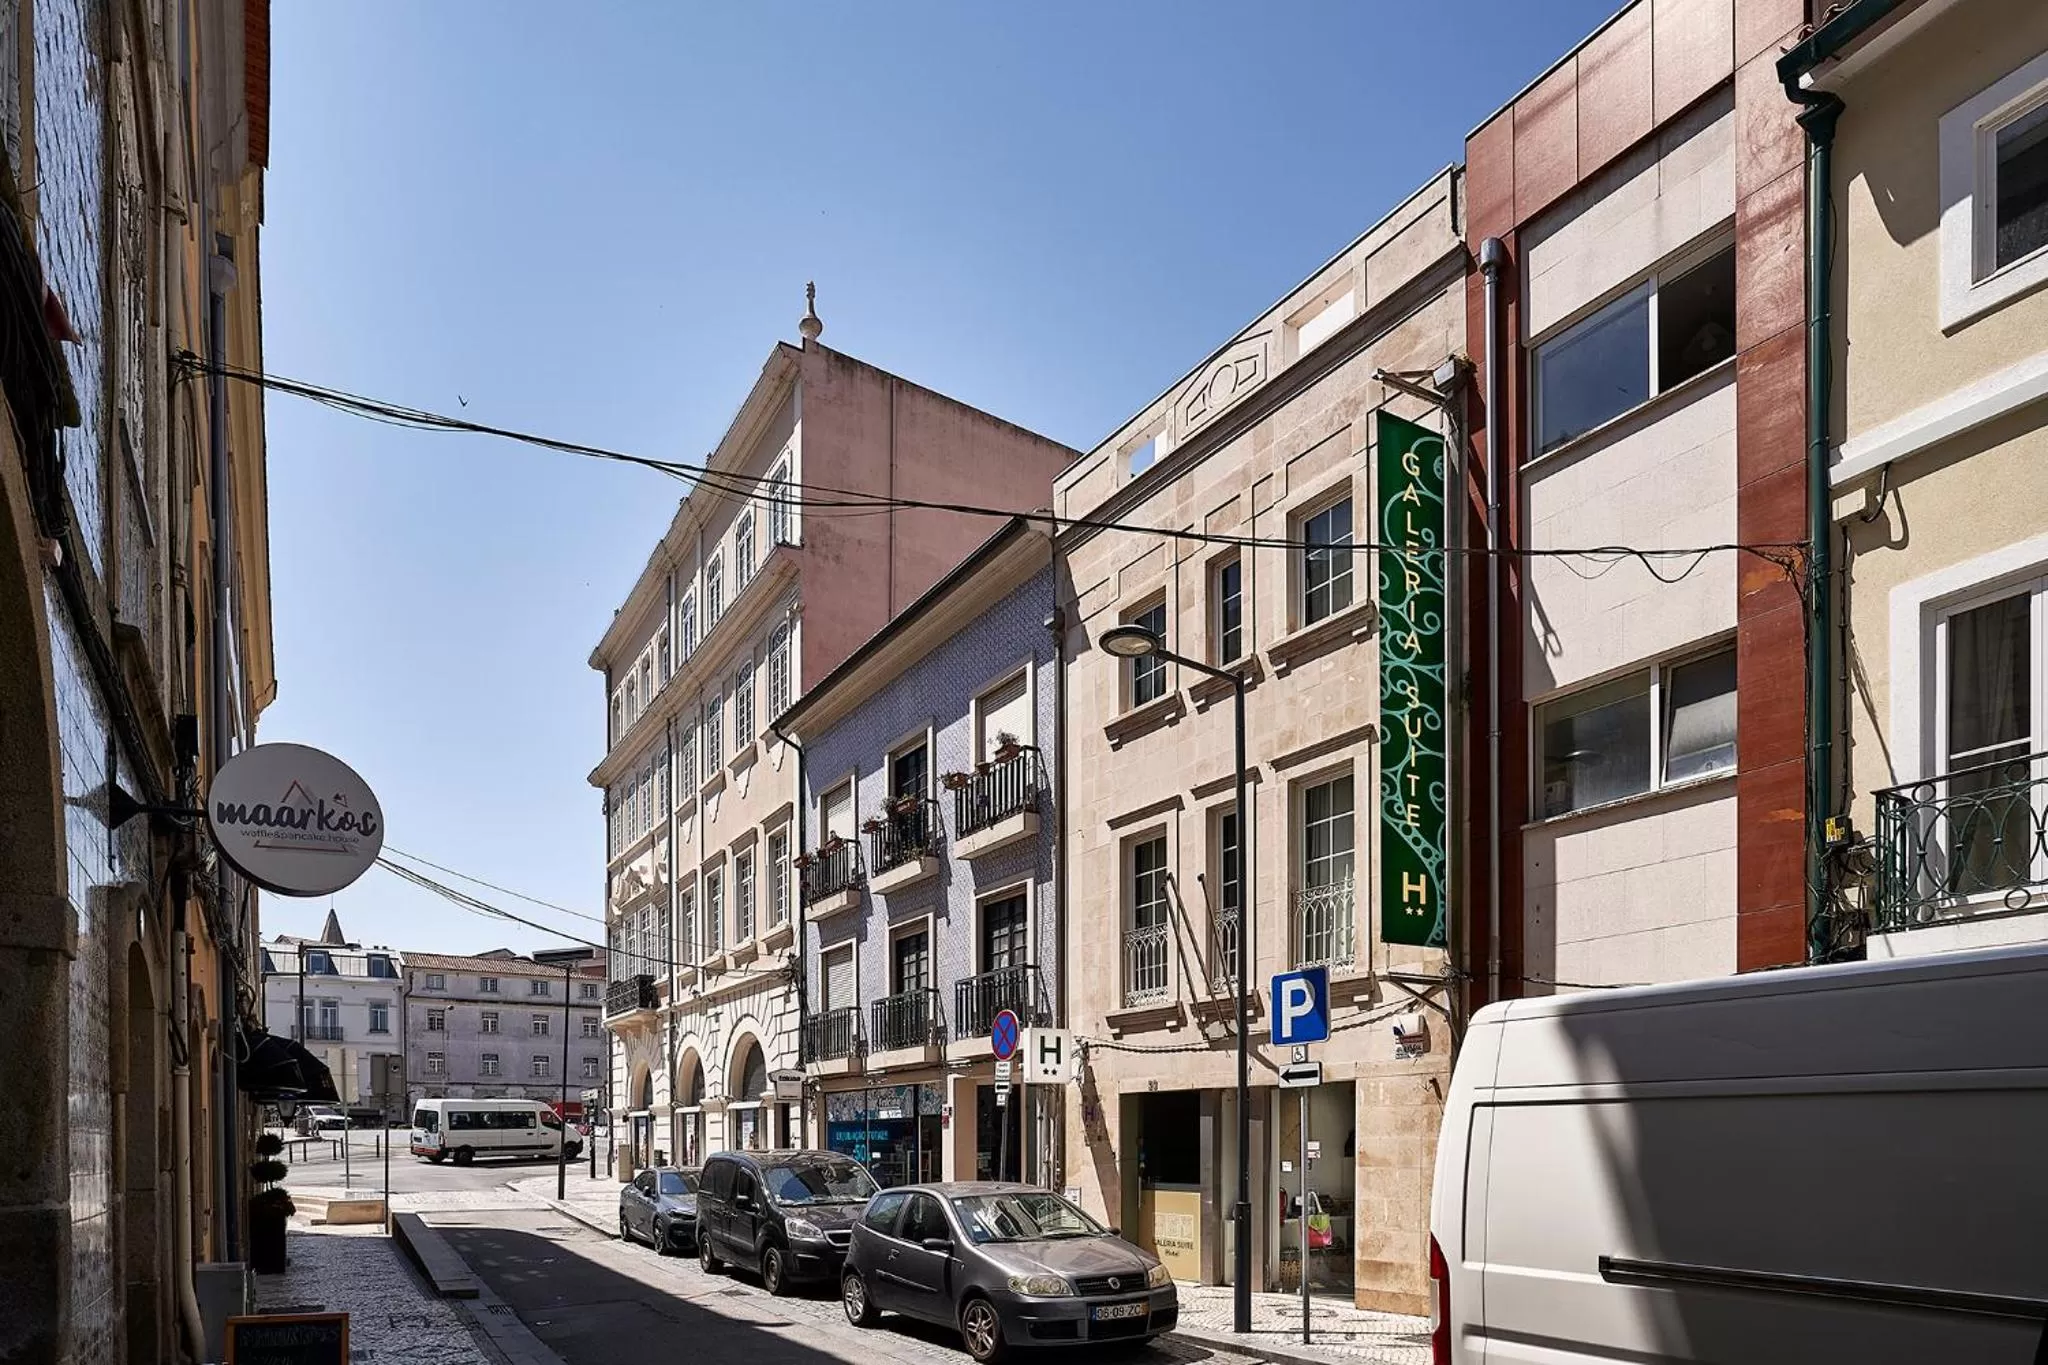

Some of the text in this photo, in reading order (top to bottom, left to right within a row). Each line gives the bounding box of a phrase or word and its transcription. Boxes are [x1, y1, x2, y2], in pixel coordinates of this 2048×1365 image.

[1401, 452, 1422, 655] GALERIA
[1404, 685, 1421, 828] SUITE
[217, 799, 378, 837] maarkos
[1402, 871, 1427, 906] H
[1281, 977, 1316, 1039] P
[1040, 1036, 1062, 1065] H
